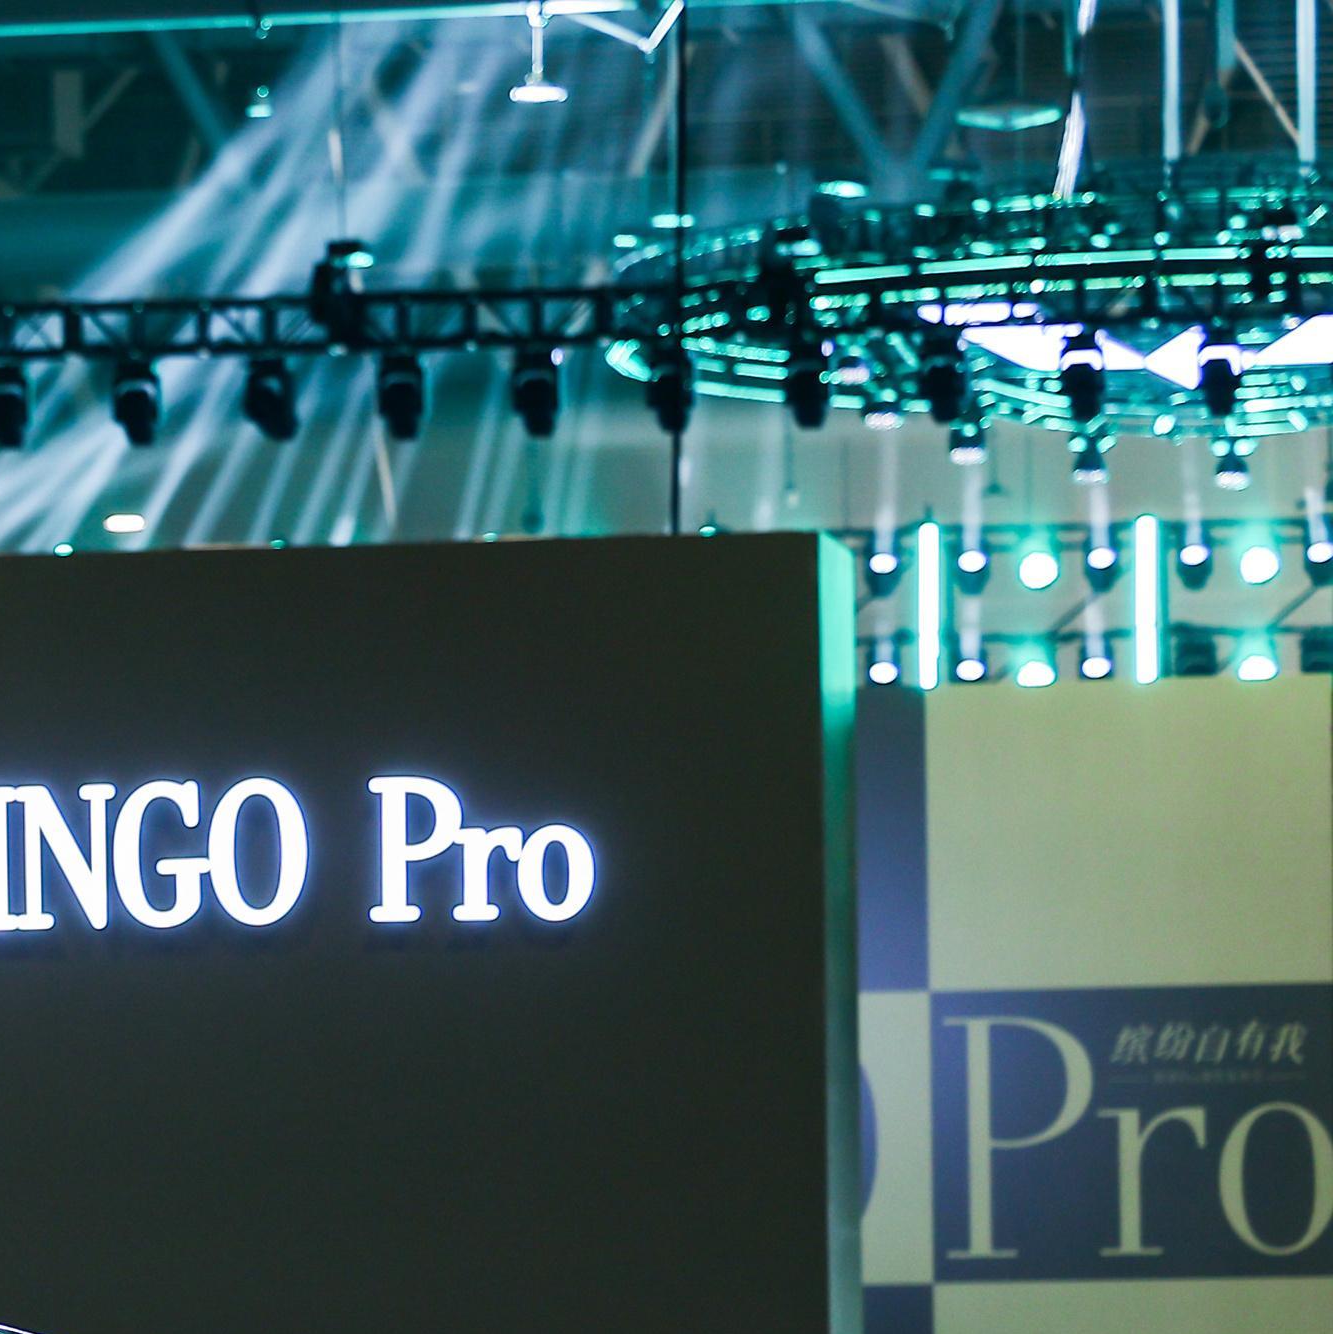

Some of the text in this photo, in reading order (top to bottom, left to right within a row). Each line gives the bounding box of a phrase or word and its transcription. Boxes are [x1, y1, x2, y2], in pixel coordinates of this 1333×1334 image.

[367, 775, 598, 923] Pro
[1109, 1017, 1308, 1065] 缤纷自有我
[942, 1015, 1333, 1259] Pro
